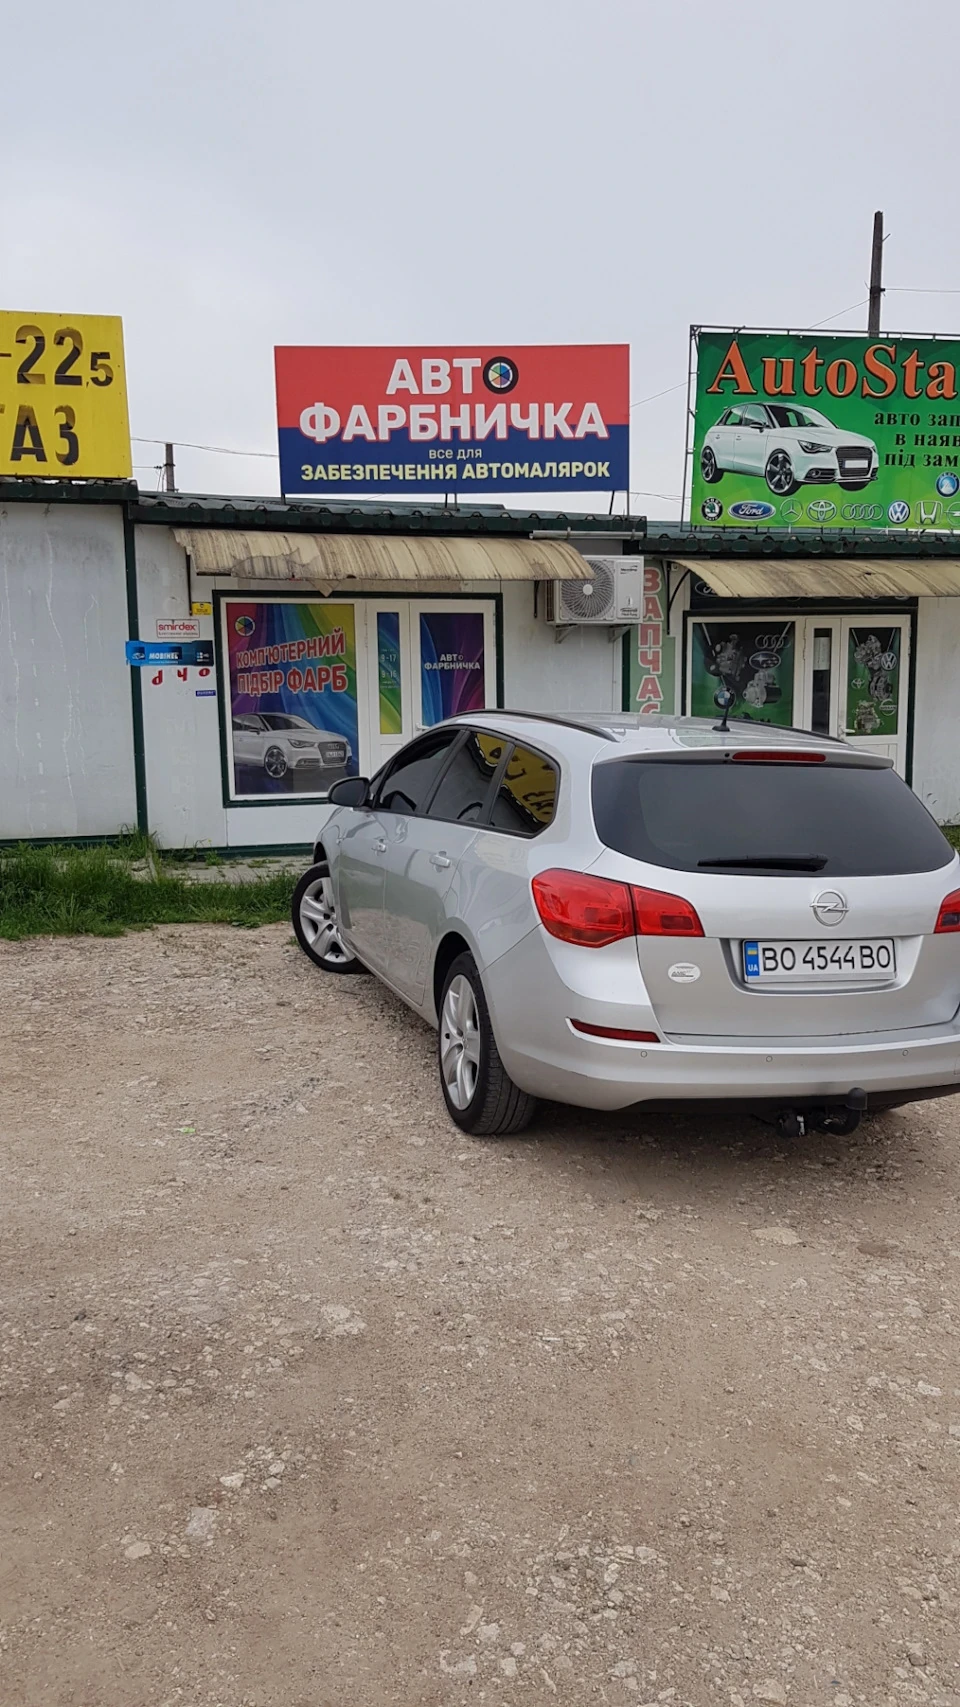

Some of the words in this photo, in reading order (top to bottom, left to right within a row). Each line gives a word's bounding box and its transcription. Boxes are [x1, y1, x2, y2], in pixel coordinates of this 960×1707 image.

[706, 340, 958, 399] AutoSta
[299, 402, 609, 442] ФАРБНИЧКА
[874, 412, 920, 426] авто
[0, 404, 79, 466] АЗ
[895, 433, 906, 446] в
[428, 450, 453, 460] все
[456, 448, 482, 460] для
[884, 449, 915, 468] під
[923, 454, 958, 467] зам
[301, 463, 458, 481] ЗАБЕЗПЕЧЕННЯ
[462, 461, 611, 479] АВТОМАЛЯРОК
[738, 503, 763, 515] Ford
[158, 622, 195, 631] smirdex
[424, 662, 480, 670] ФАРБНИЧКА
[237, 671, 284, 697] ПІДБІР
[287, 665, 347, 694] ФАРБ
[802, 945, 856, 970] 4544
